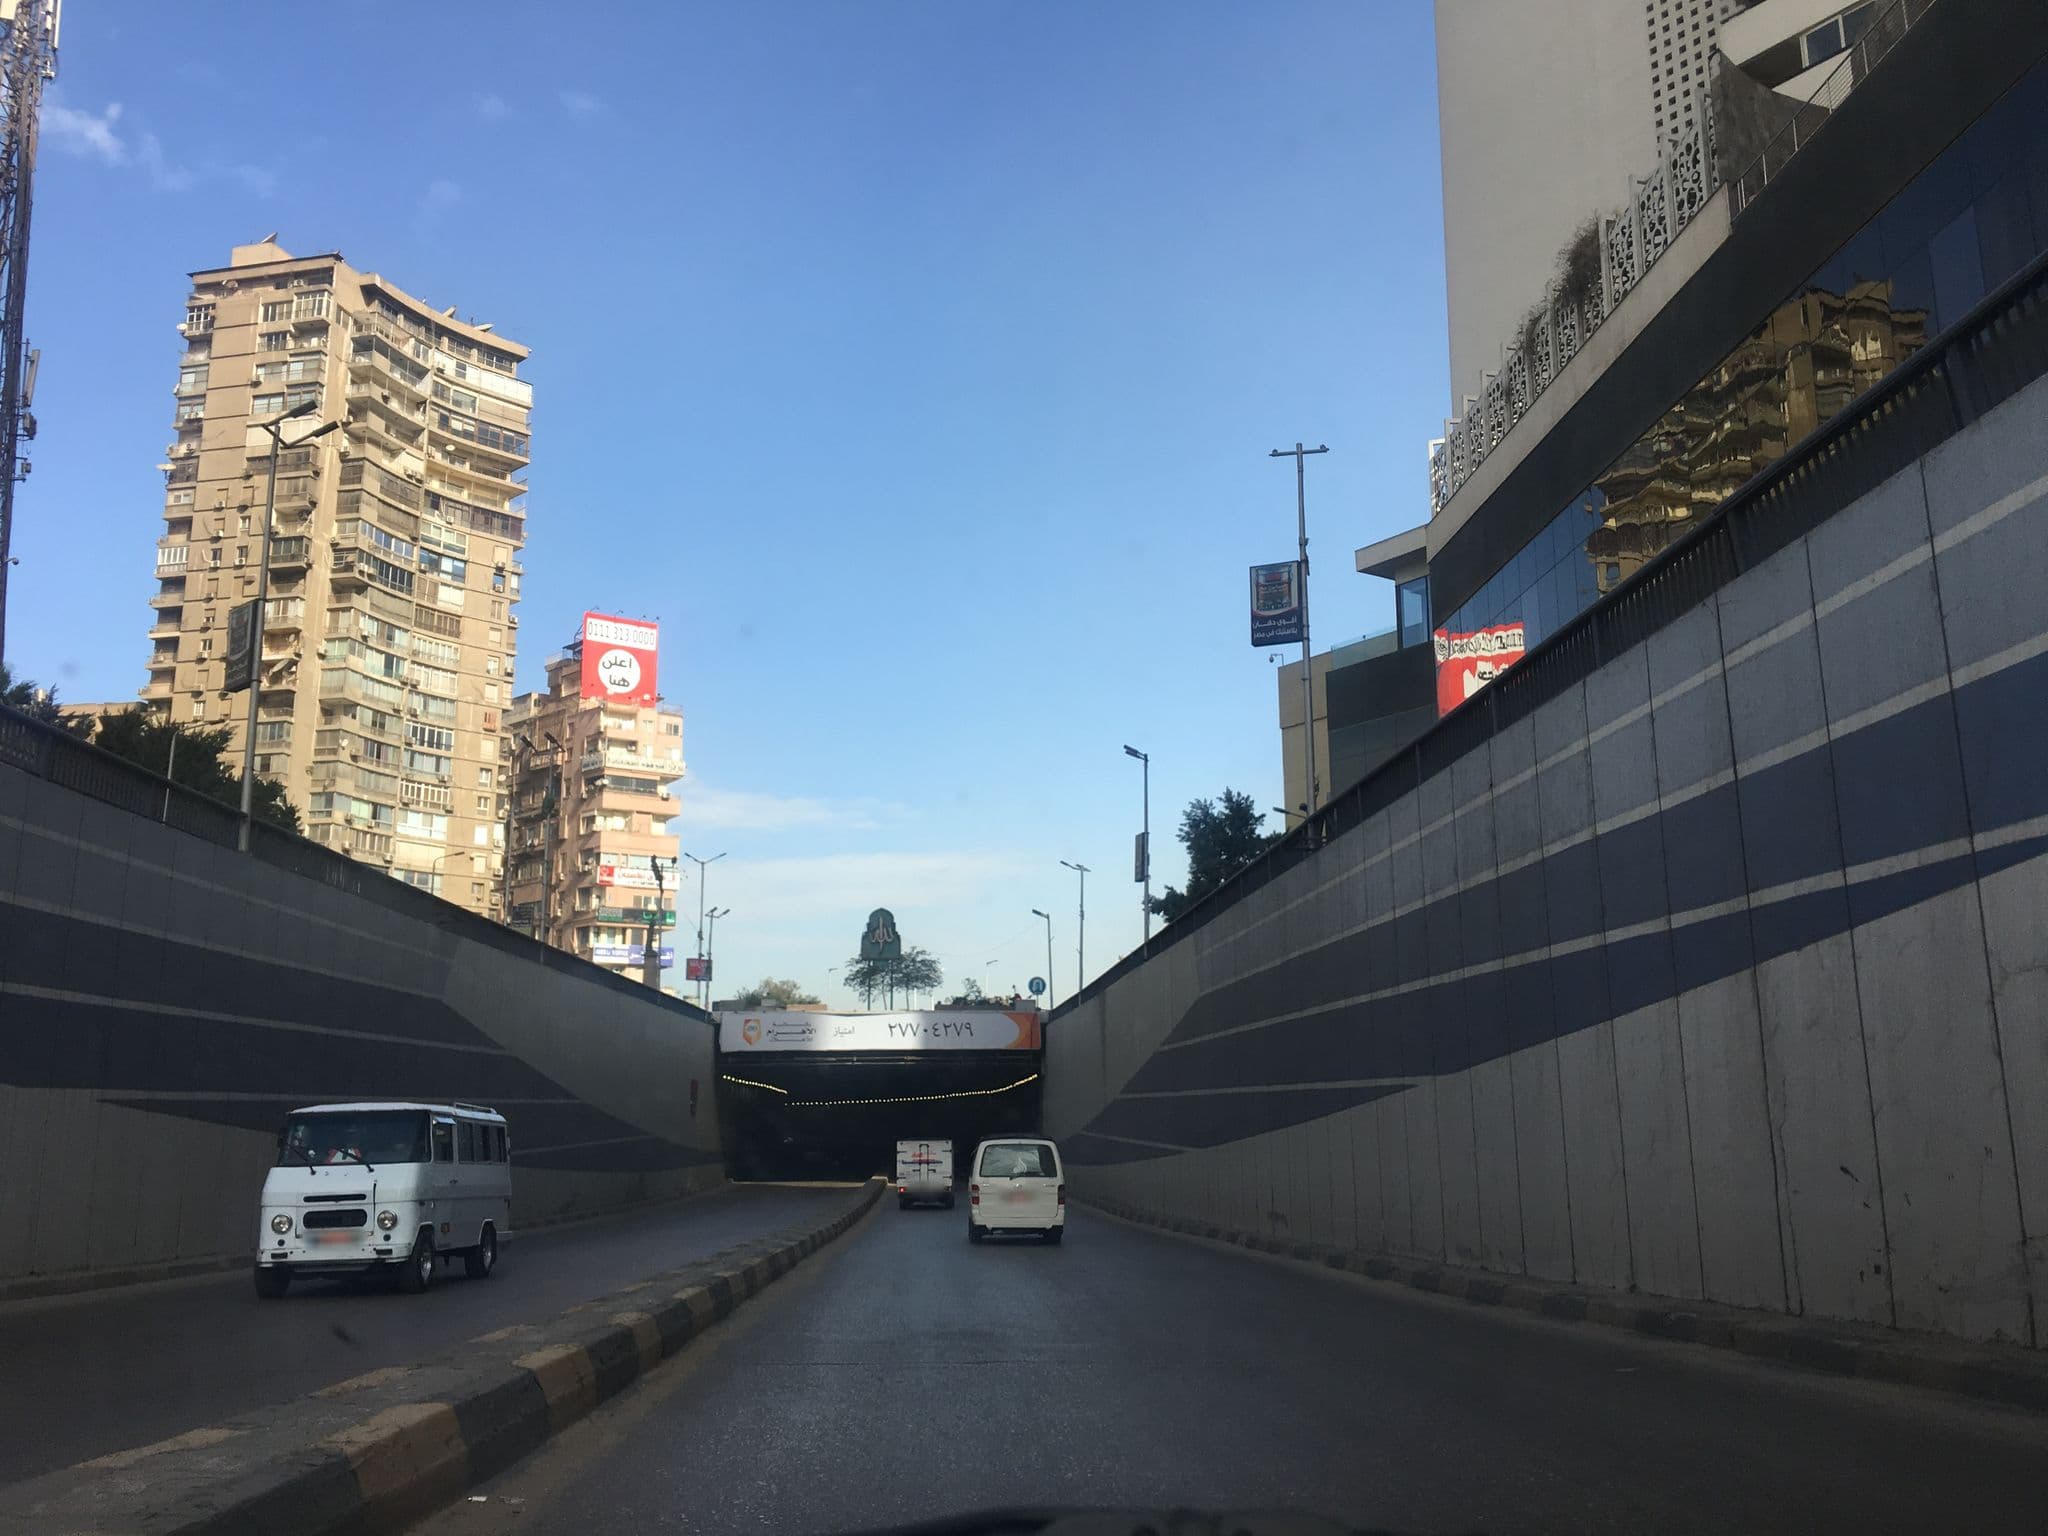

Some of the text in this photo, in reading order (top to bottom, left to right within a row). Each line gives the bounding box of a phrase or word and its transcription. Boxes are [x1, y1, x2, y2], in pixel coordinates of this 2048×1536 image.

[588, 621, 655, 646] 0111 313 0000
[609, 674, 630, 688] هنا
[887, 1021, 976, 1038] ٢٧٧٠٤٢٧٩
